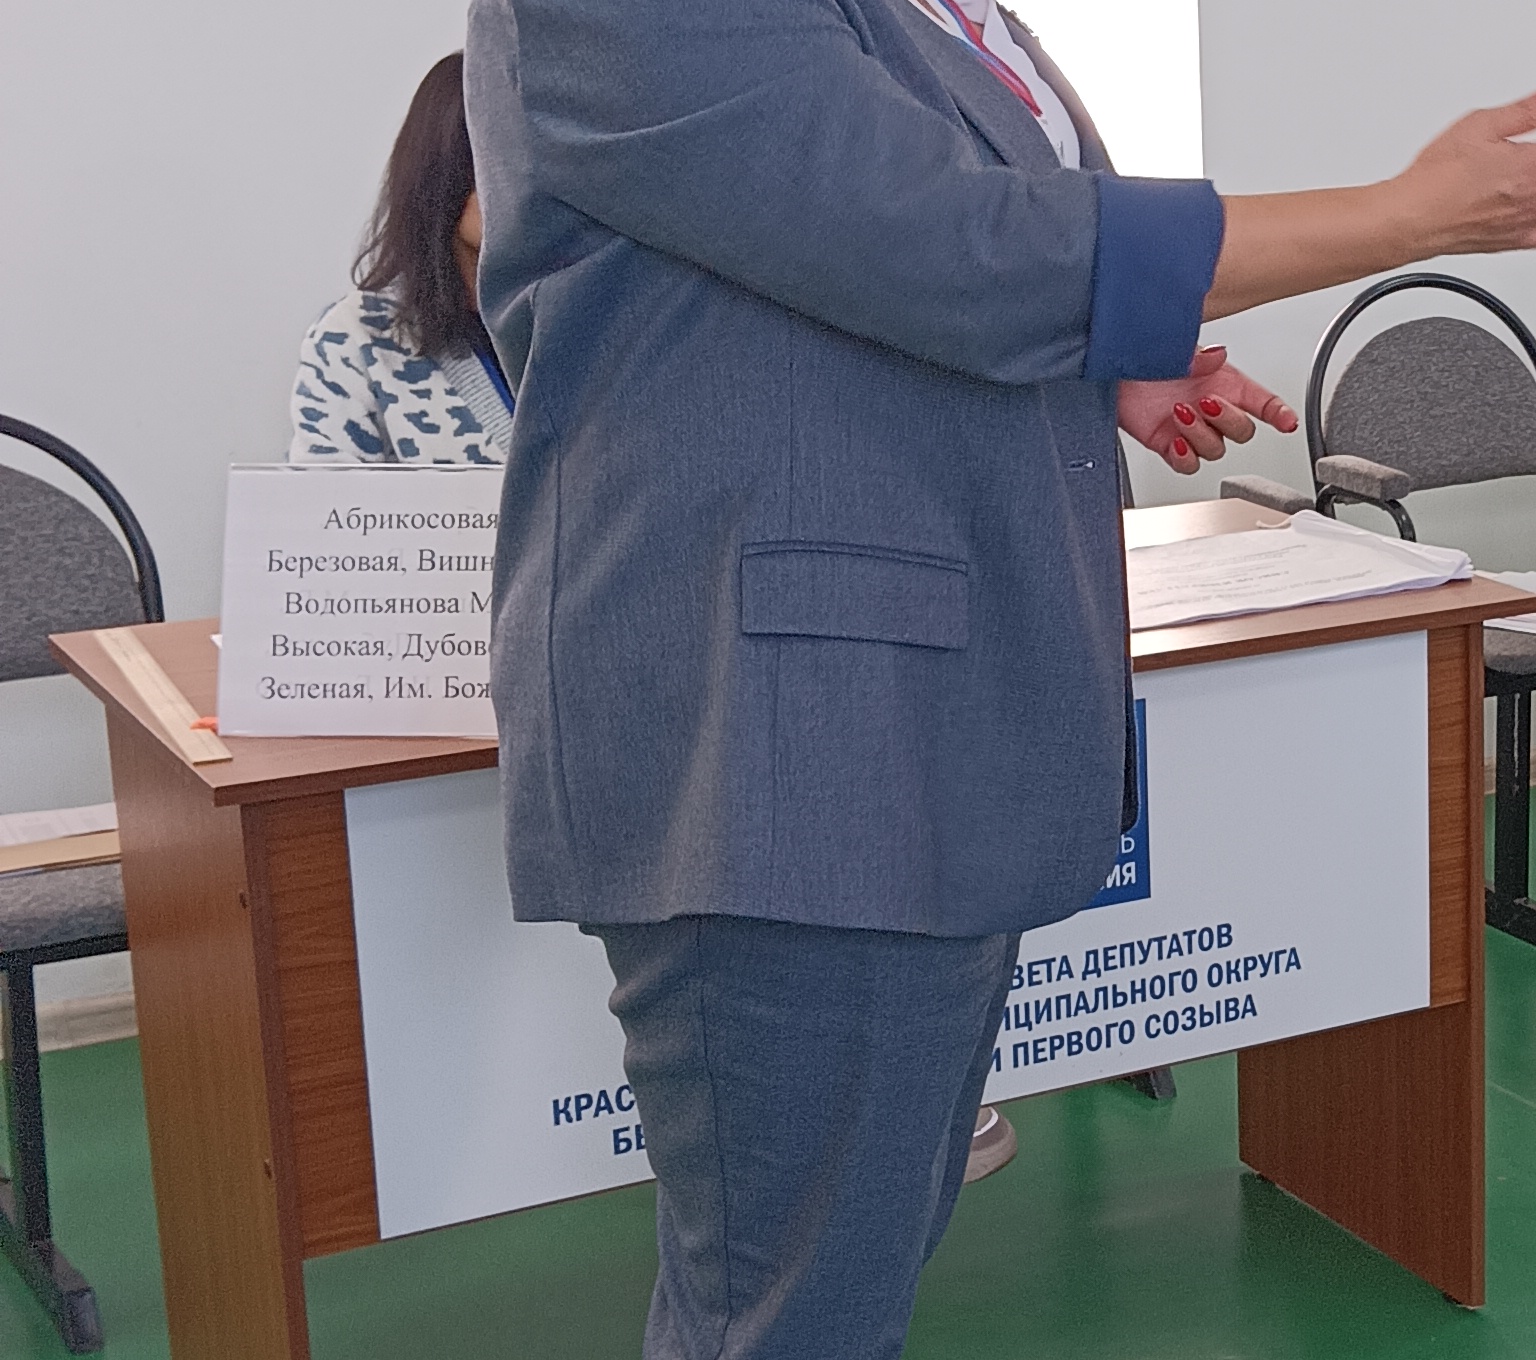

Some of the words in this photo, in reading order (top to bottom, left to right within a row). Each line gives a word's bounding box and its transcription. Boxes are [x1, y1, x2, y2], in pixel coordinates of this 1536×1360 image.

[324, 507, 499, 535] Абрикосовая
[268, 549, 407, 578] Березовая,
[285, 592, 460, 616] Водопьянова
[271, 634, 393, 661] Высокая,
[402, 633, 491, 662] Дубов
[261, 676, 373, 701] Зеленая,
[384, 676, 432, 698] Им.
[1011, 955, 1075, 990] ВЕТА
[1082, 923, 1233, 981] ДЕПУТАТОВ
[552, 1083, 636, 1126] КРАС
[1207, 947, 1302, 988] ОКРУГА
[1012, 1019, 1135, 1069] ПЕРВОГО
[1144, 993, 1258, 1039] СОЗЫВА
